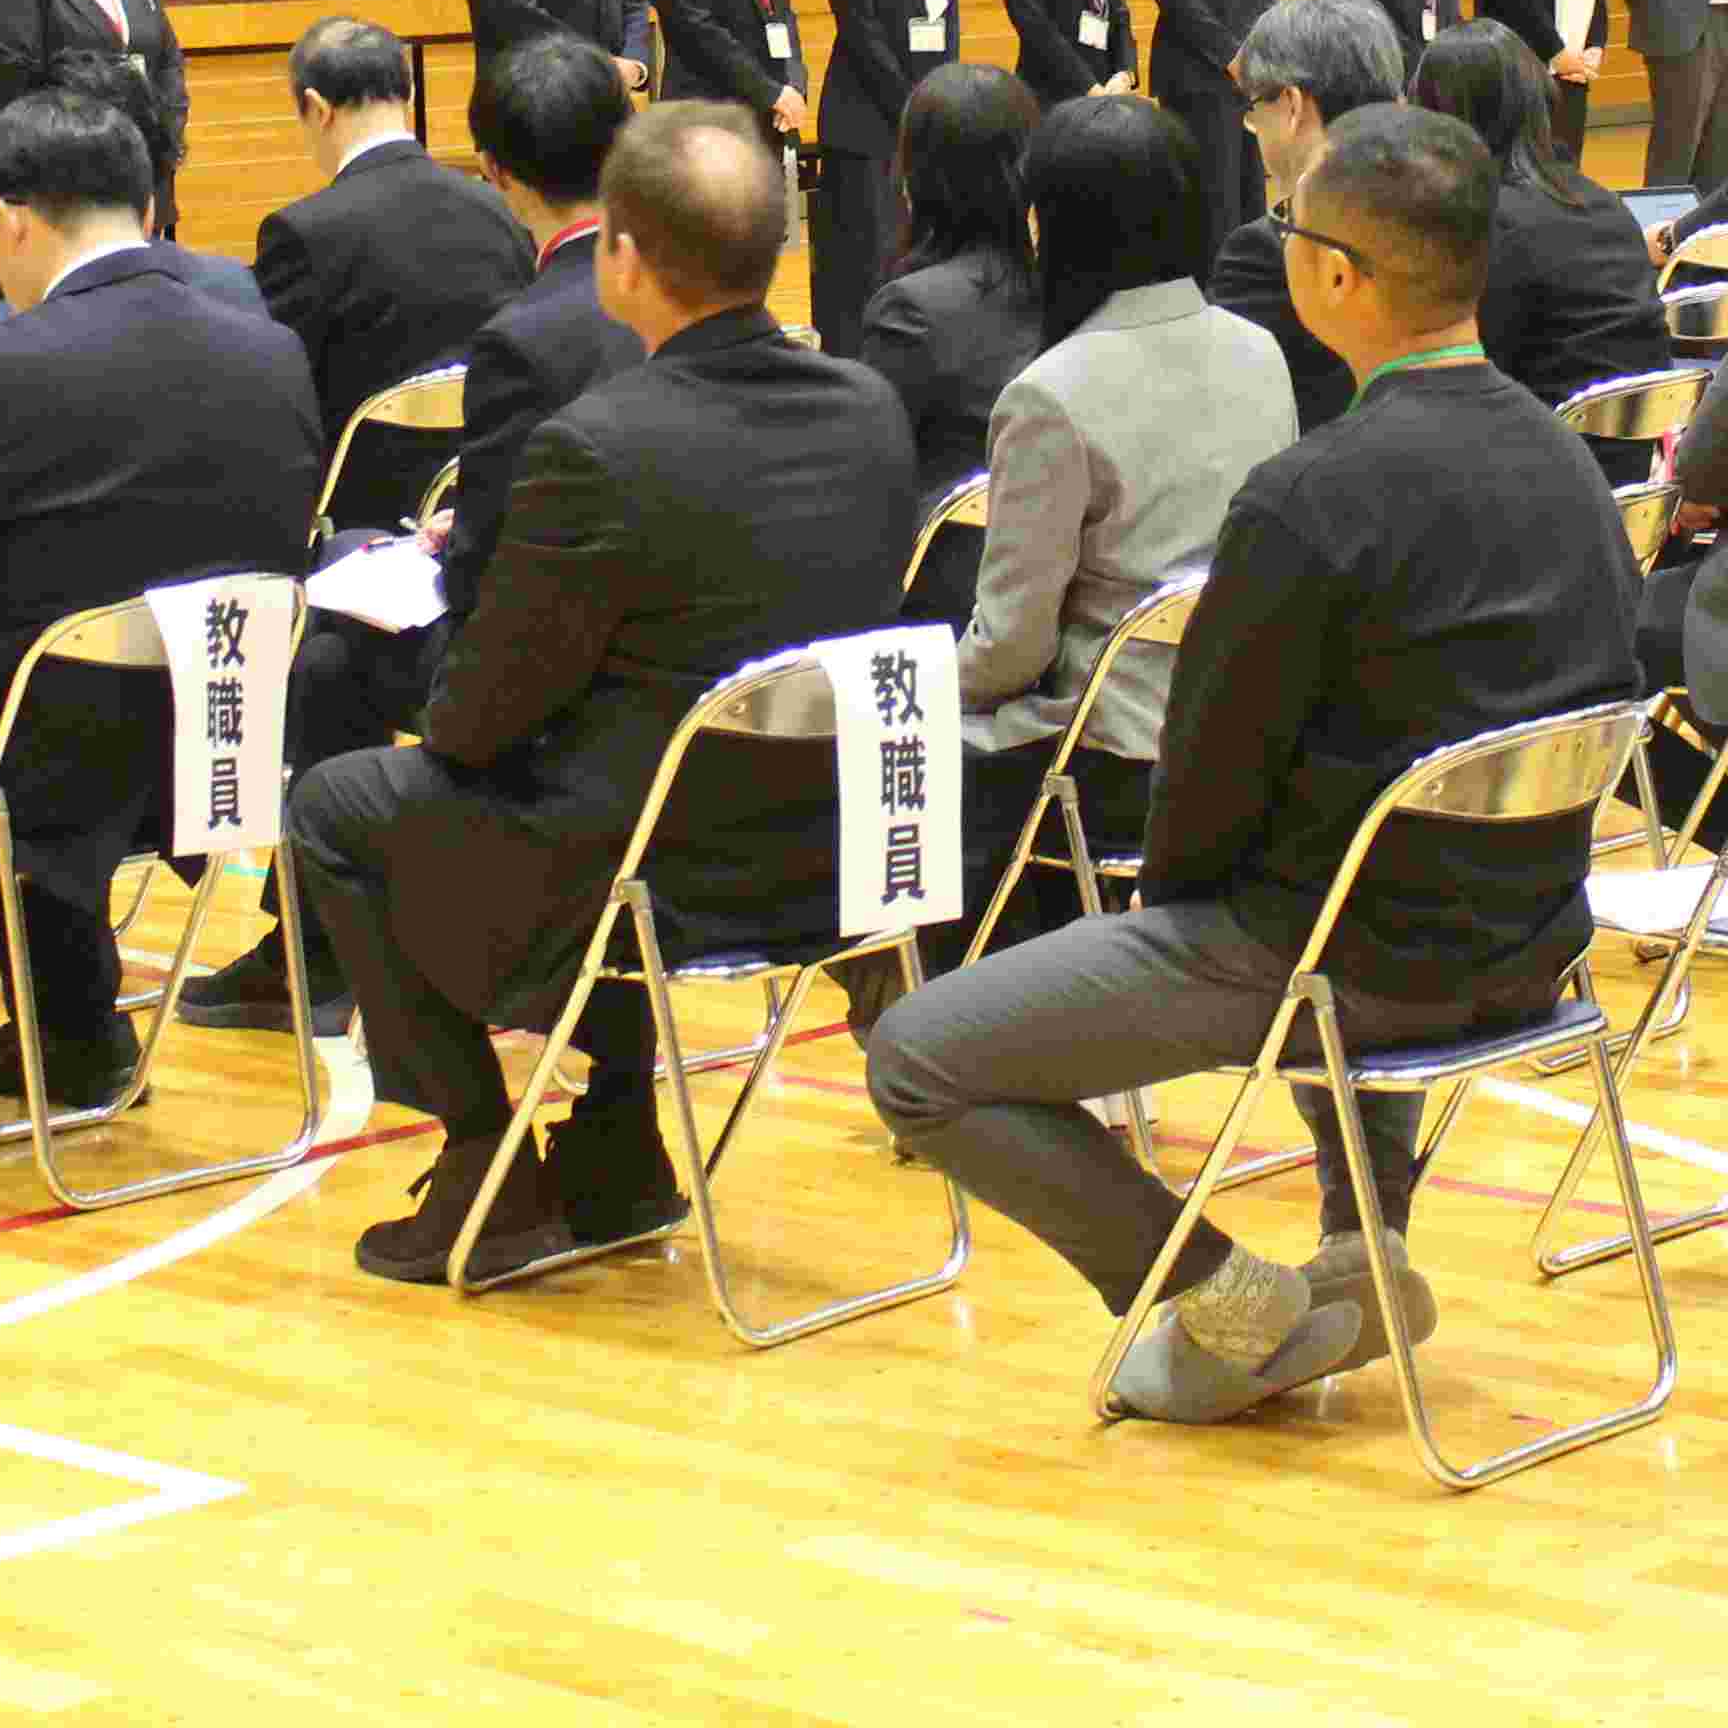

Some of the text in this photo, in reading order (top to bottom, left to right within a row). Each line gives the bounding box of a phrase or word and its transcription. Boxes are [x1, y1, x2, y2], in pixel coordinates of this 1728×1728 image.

[205, 597, 249, 831] 教職員
[870, 650, 927, 906] 教職員
